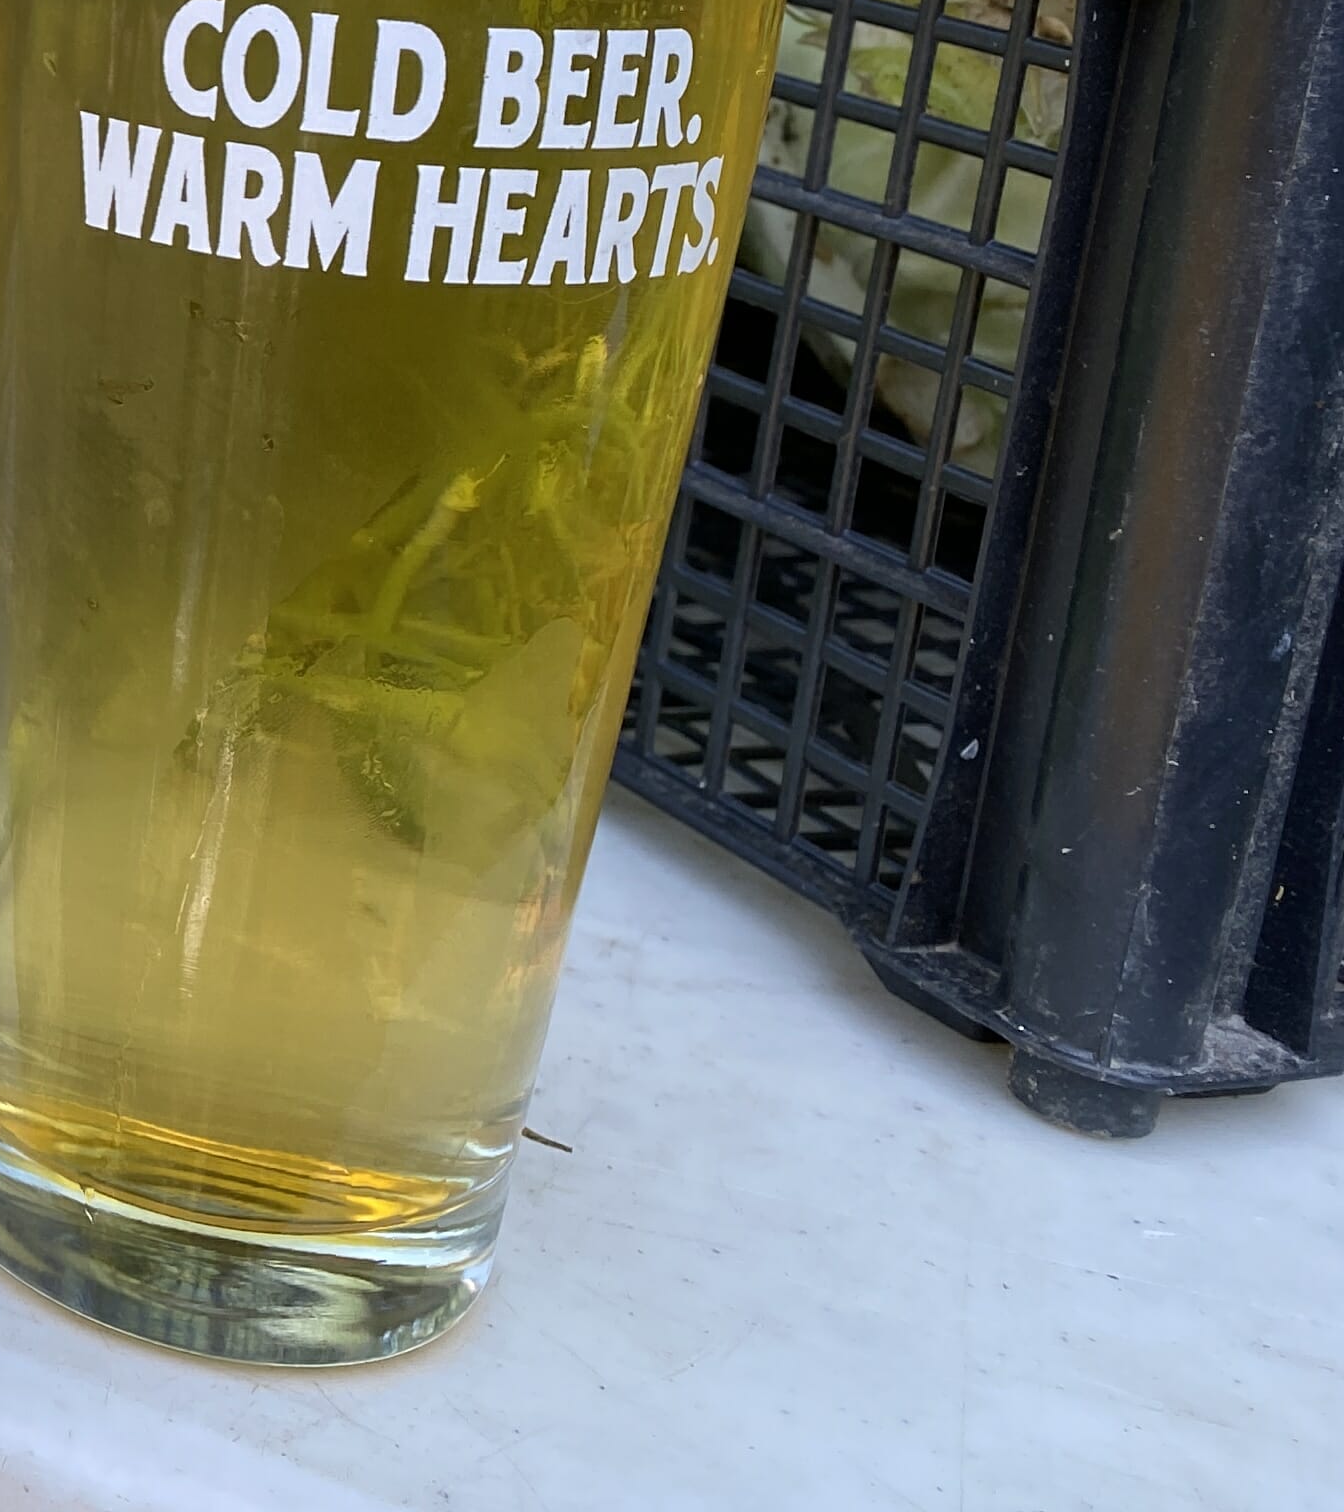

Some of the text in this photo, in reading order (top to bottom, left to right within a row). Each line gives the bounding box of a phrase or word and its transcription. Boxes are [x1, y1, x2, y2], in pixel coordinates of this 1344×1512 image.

[473, 27, 703, 151] BEER.
[79, 110, 725, 287] WARM HEARTS.
